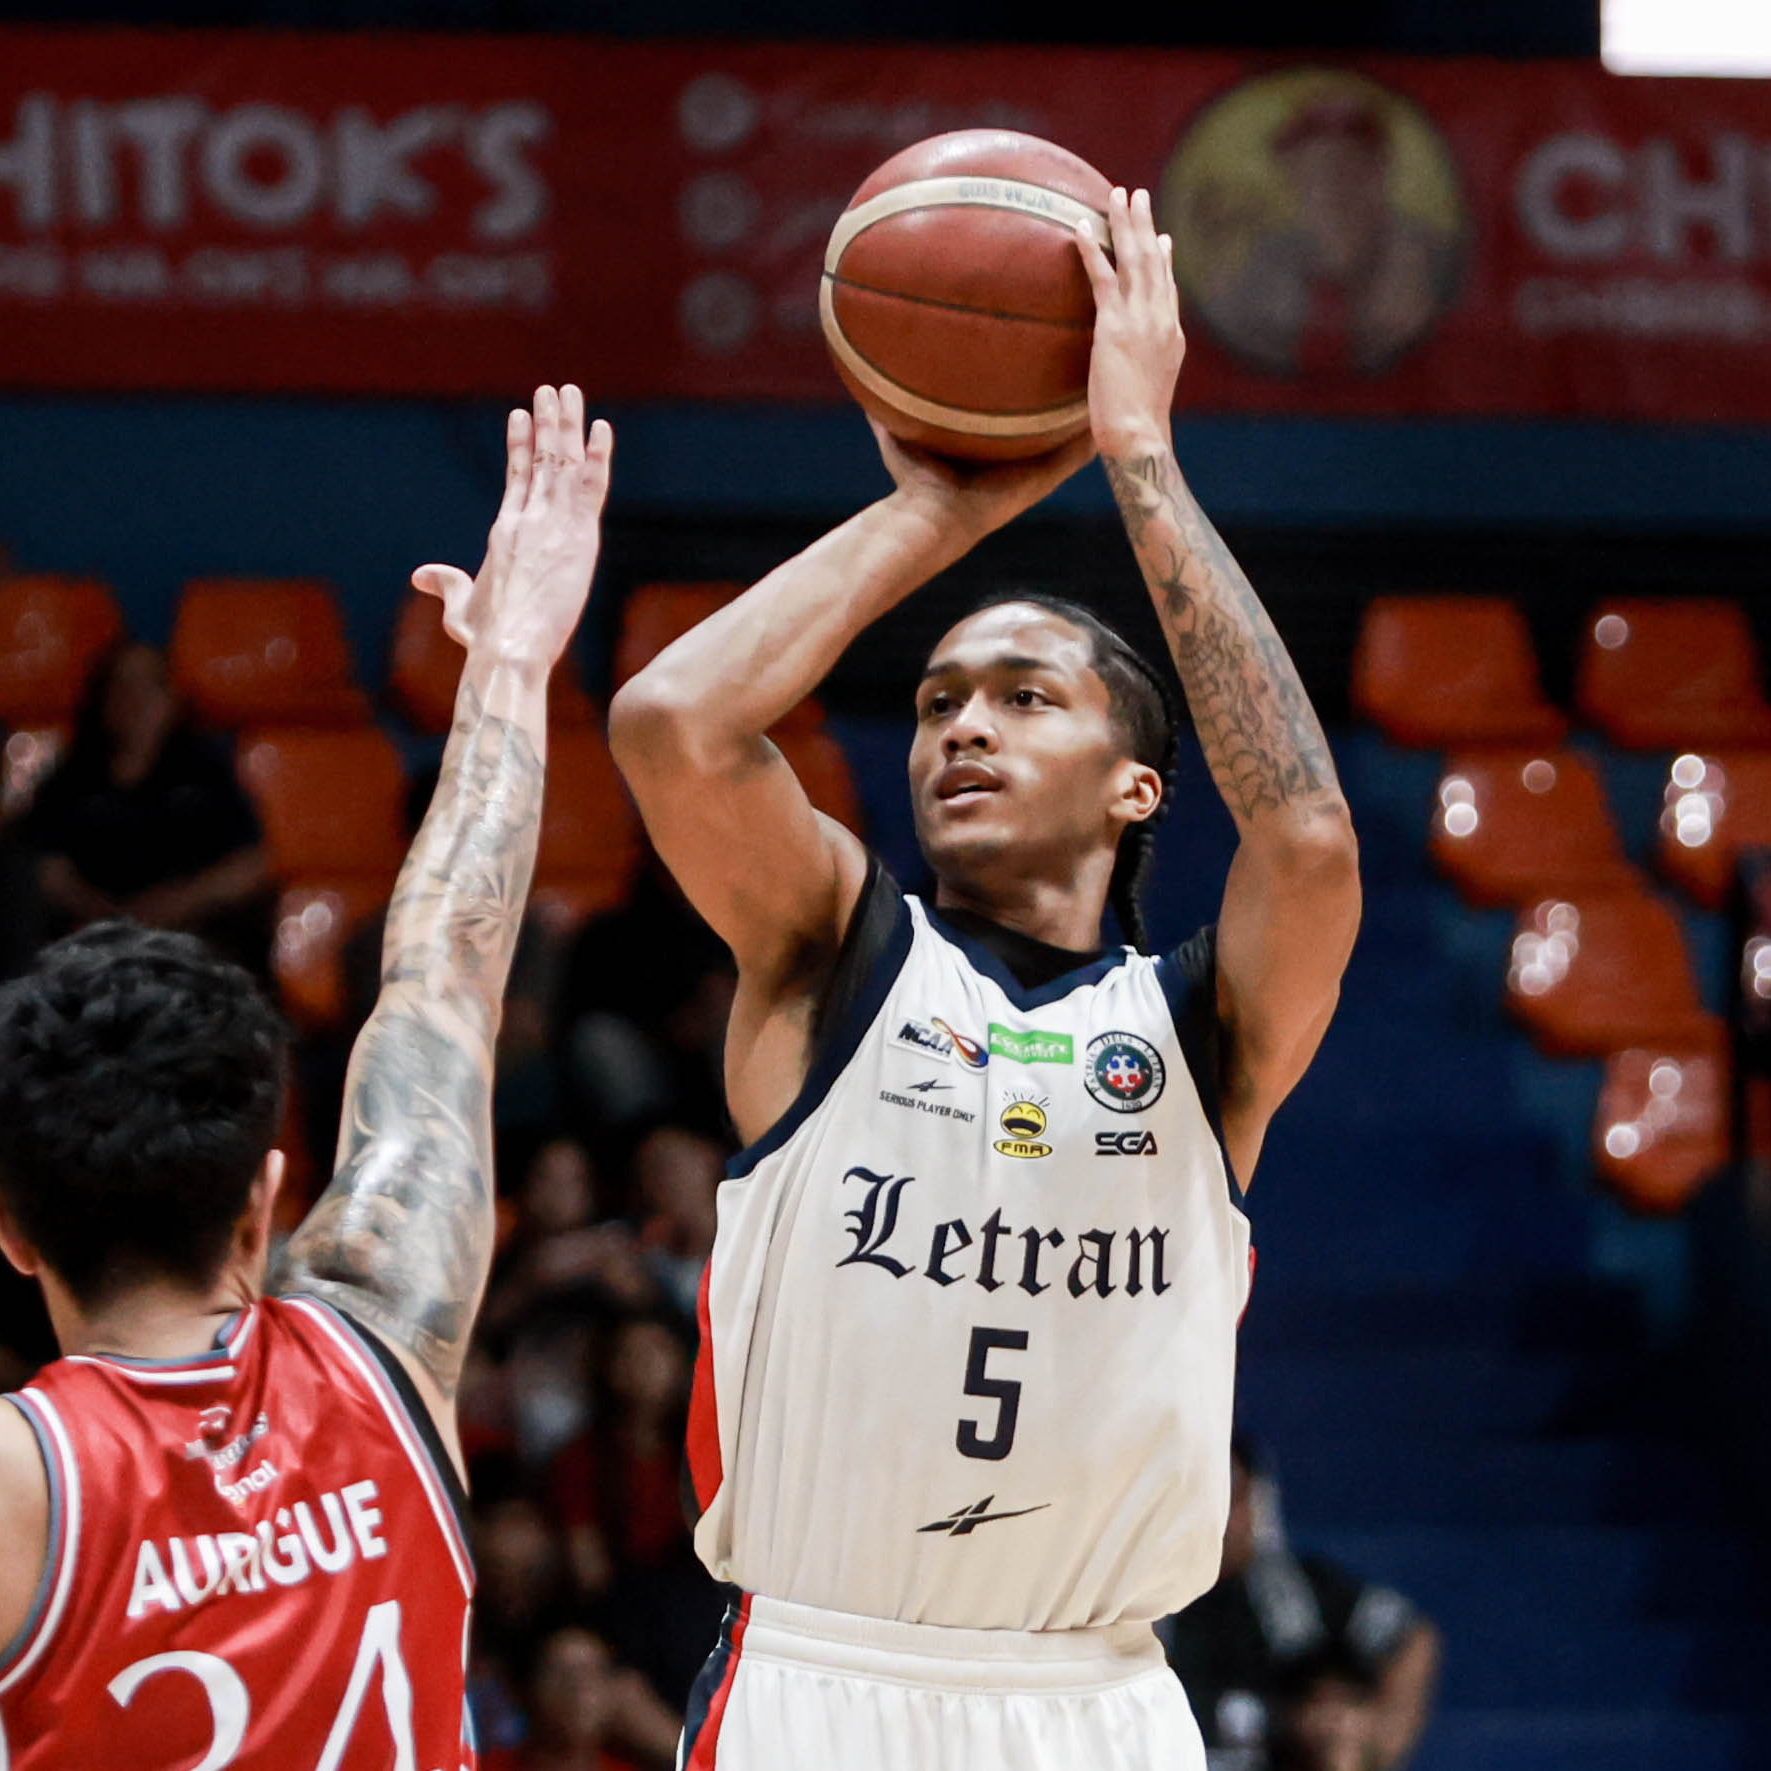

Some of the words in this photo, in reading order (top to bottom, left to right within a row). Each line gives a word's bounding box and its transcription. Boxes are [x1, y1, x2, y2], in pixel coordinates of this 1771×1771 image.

[897, 1021, 954, 1055] NCAA
[879, 1090, 916, 1109] SERIOUS
[916, 1099, 952, 1117] PLAYER
[952, 1107, 976, 1124] ONLY
[1000, 1142, 1044, 1155] FMA
[1094, 1130, 1158, 1156] SGA
[835, 1166, 1172, 1299] Letran
[956, 1326, 1029, 1461] 5
